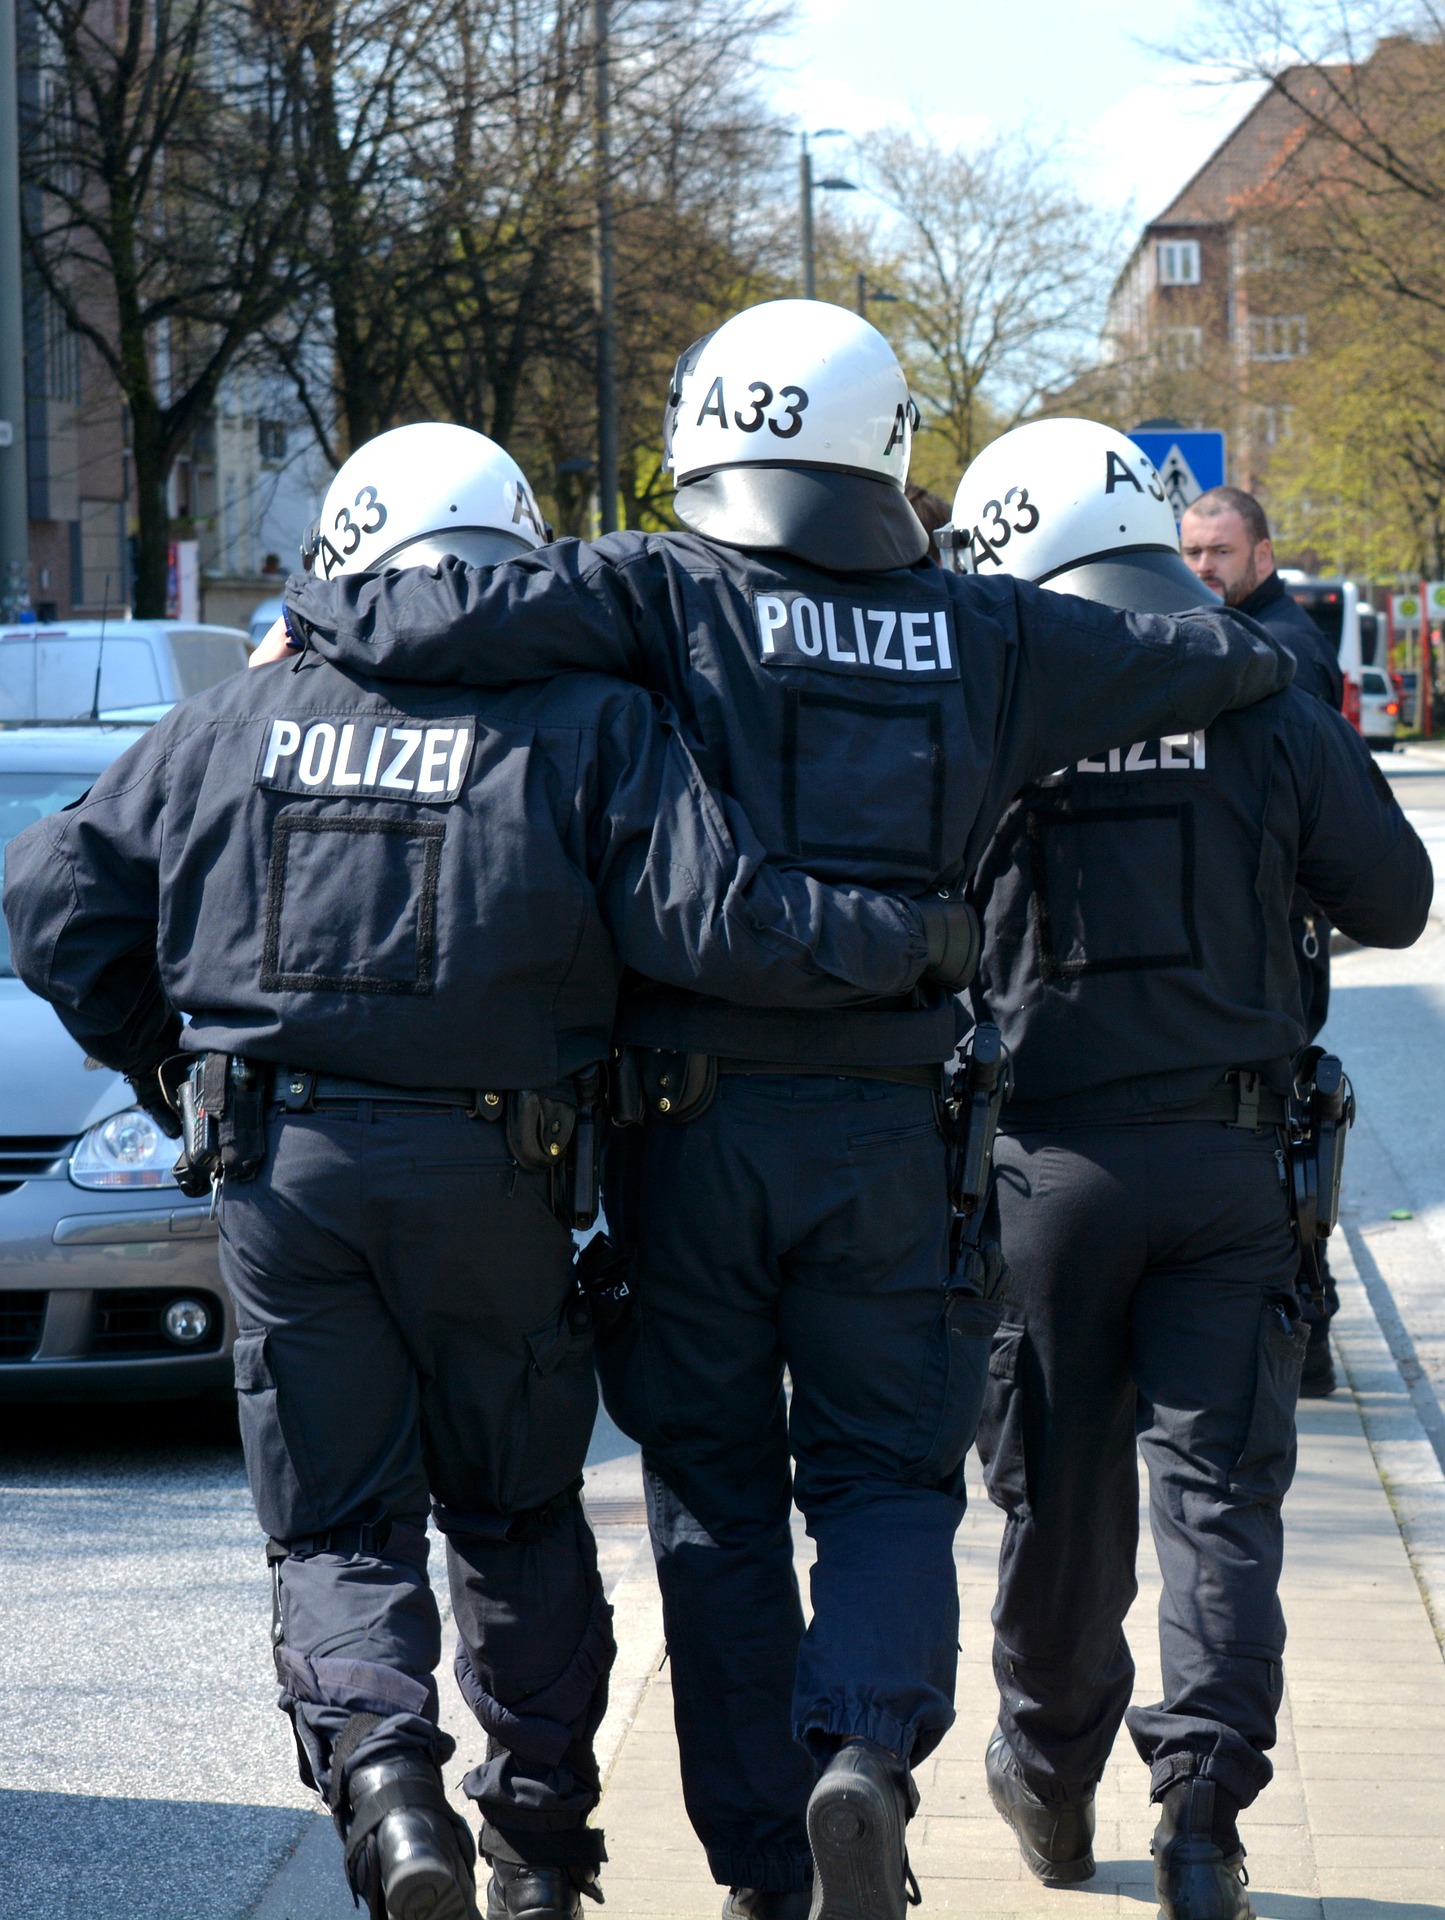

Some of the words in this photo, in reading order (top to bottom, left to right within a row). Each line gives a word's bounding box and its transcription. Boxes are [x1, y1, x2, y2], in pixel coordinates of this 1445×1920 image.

[696, 376, 809, 439] A33
[321, 485, 388, 580] A33
[970, 486, 1040, 574] A33
[756, 596, 953, 672] POLIZEI
[261, 719, 470, 793] POLIZEI
[1051, 728, 1206, 777] LIZEI
